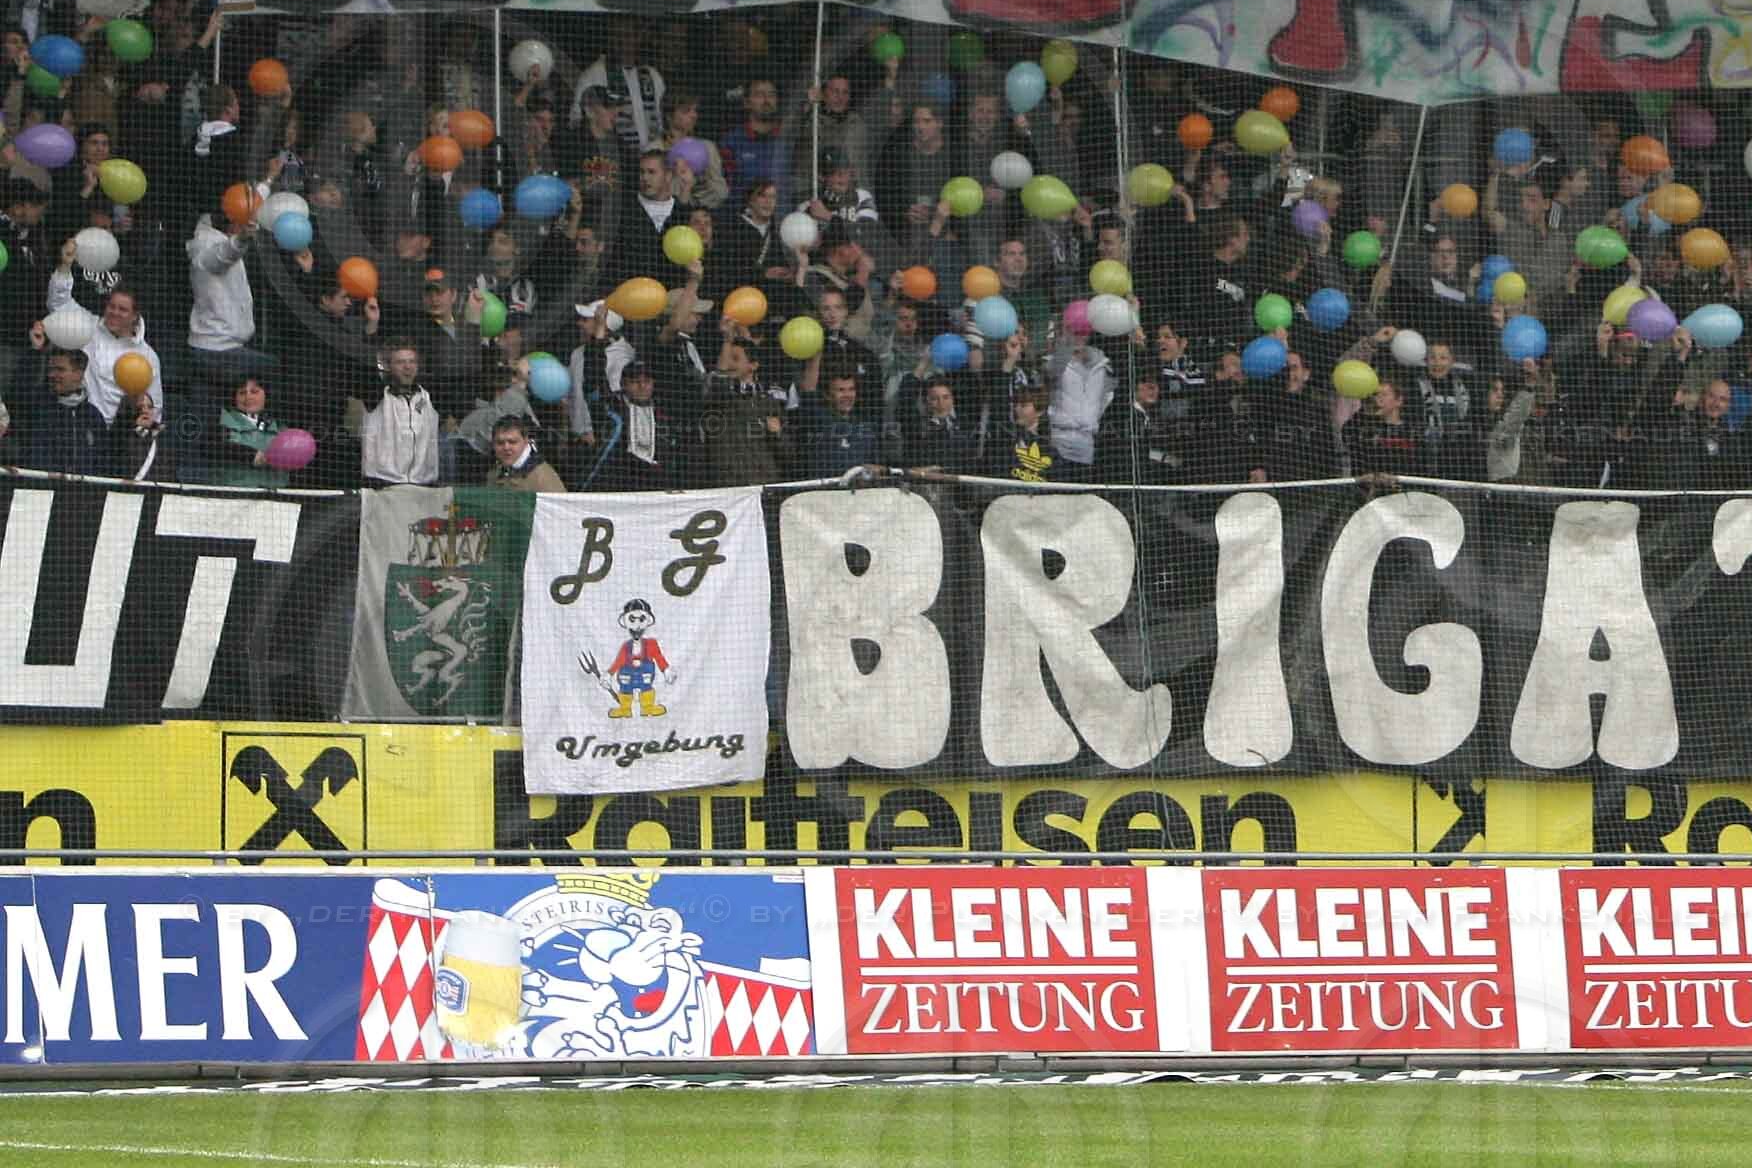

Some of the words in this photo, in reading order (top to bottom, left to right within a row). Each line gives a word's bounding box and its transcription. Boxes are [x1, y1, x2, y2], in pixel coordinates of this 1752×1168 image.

[550, 516, 614, 605] B
[0, 489, 302, 709] UT
[555, 730, 745, 768] Umgebung
[856, 887, 1139, 962] KLEINE
[1220, 887, 1498, 959] KLEINE
[3, 902, 310, 1044] MER
[861, 980, 1146, 1038] ZEITUNG
[1226, 978, 1504, 1033] ZEITUNG
